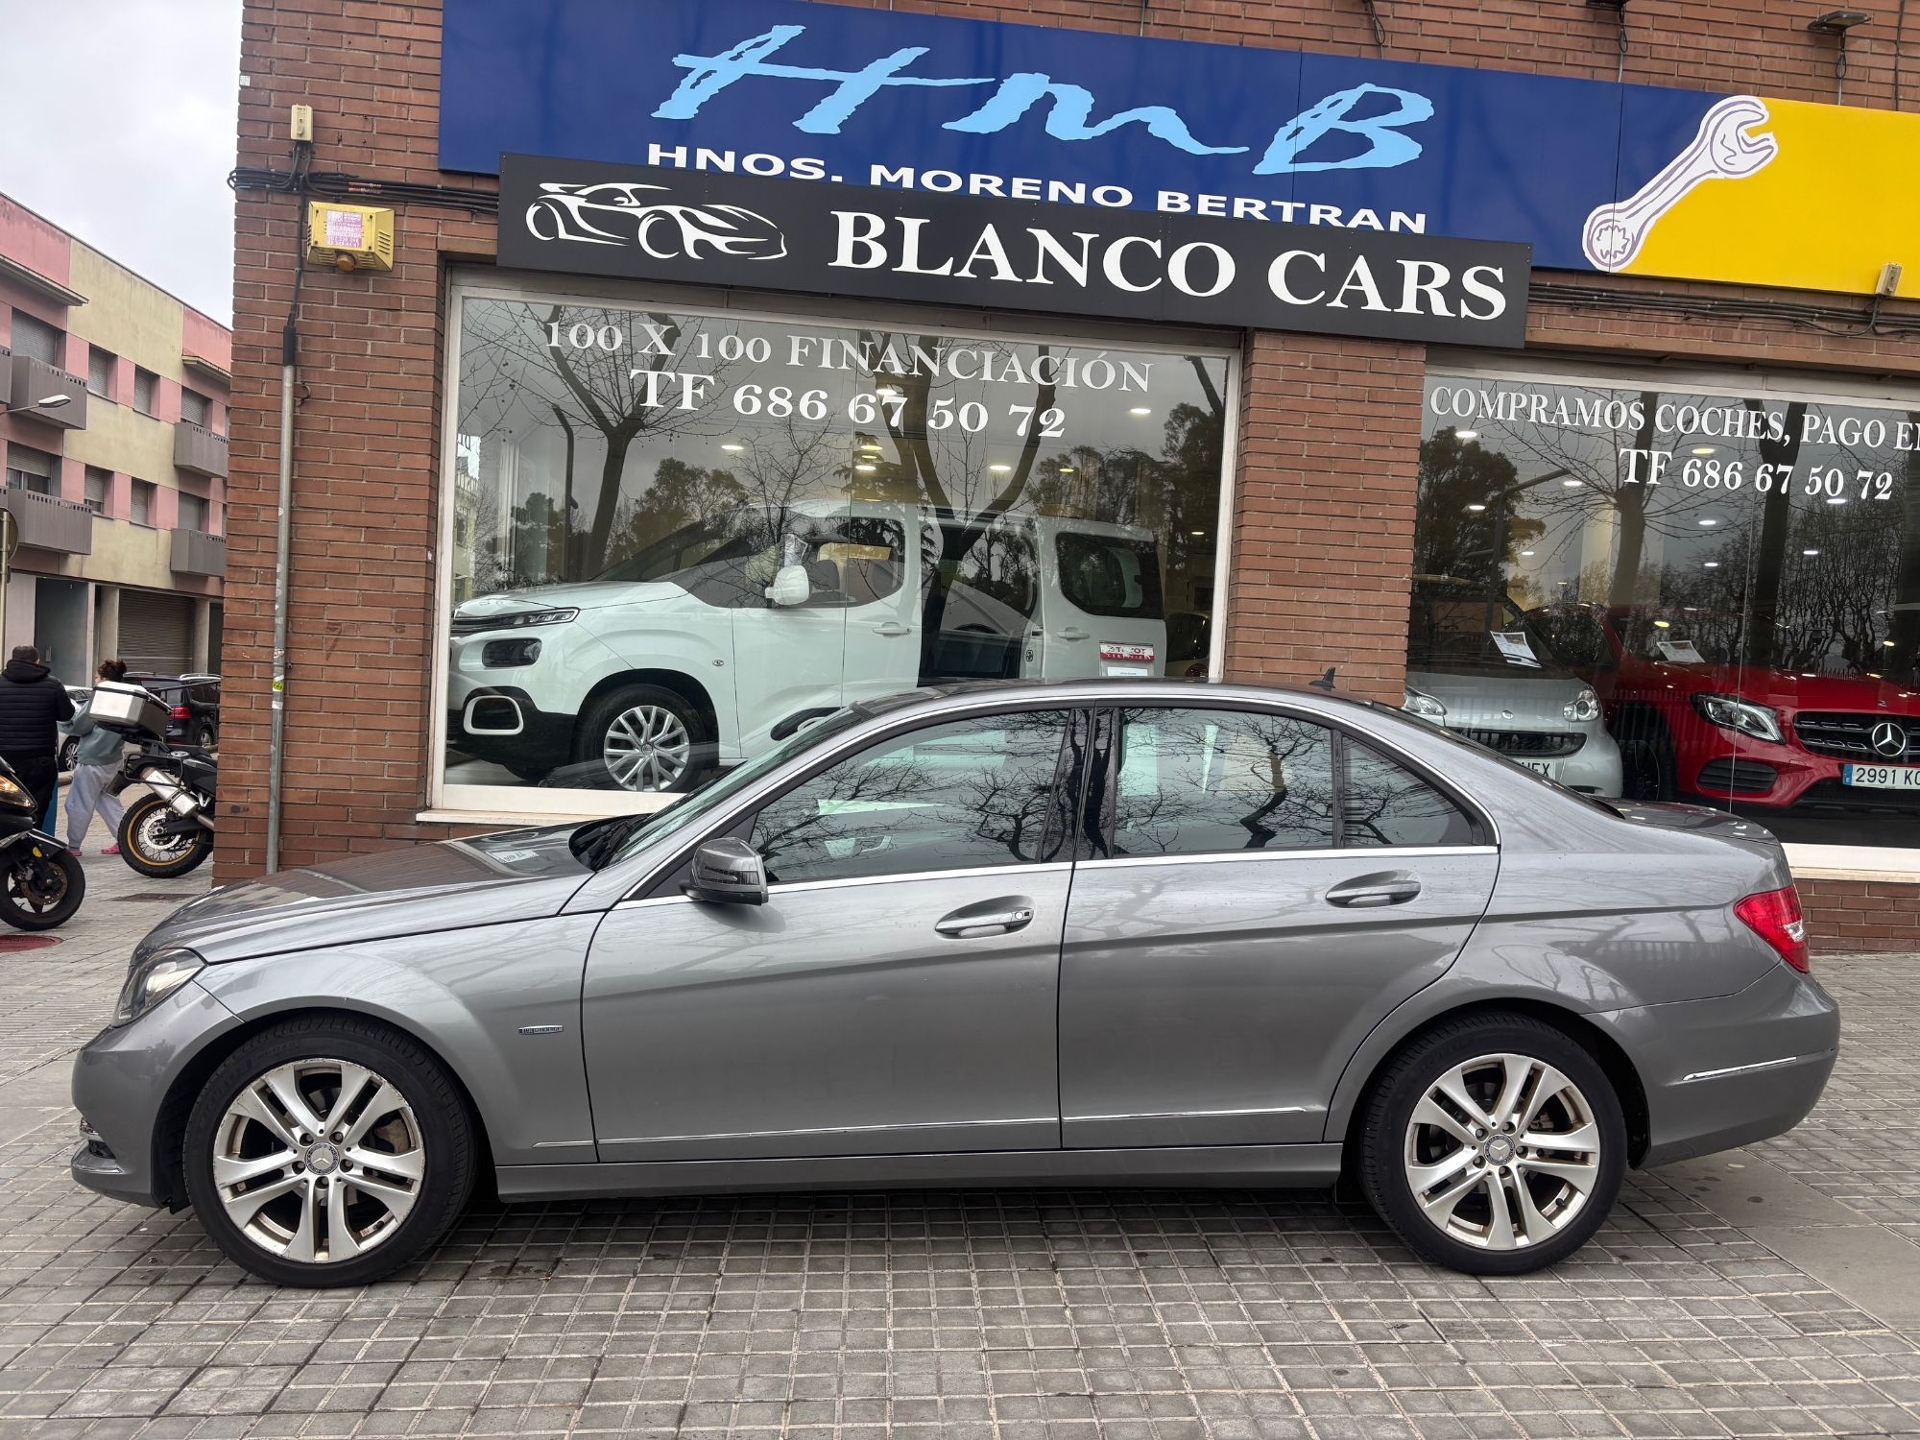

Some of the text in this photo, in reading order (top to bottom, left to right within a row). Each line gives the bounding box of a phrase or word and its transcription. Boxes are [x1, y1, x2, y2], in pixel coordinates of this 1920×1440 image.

[648, 143, 1426, 234] HNOS. MORENO BERTRAN
[827, 210, 1506, 321] BLANCO CARS
[546, 321, 1154, 393] 100 X 100 FINANCIACIÓN
[629, 368, 1067, 438] TF 686 67 50 72
[1430, 386, 1920, 451] COMPRAMOS COCHES, PAGO E
[1618, 447, 1893, 500] TF 686 67 50 72
[1855, 767, 1897, 785] 2991
